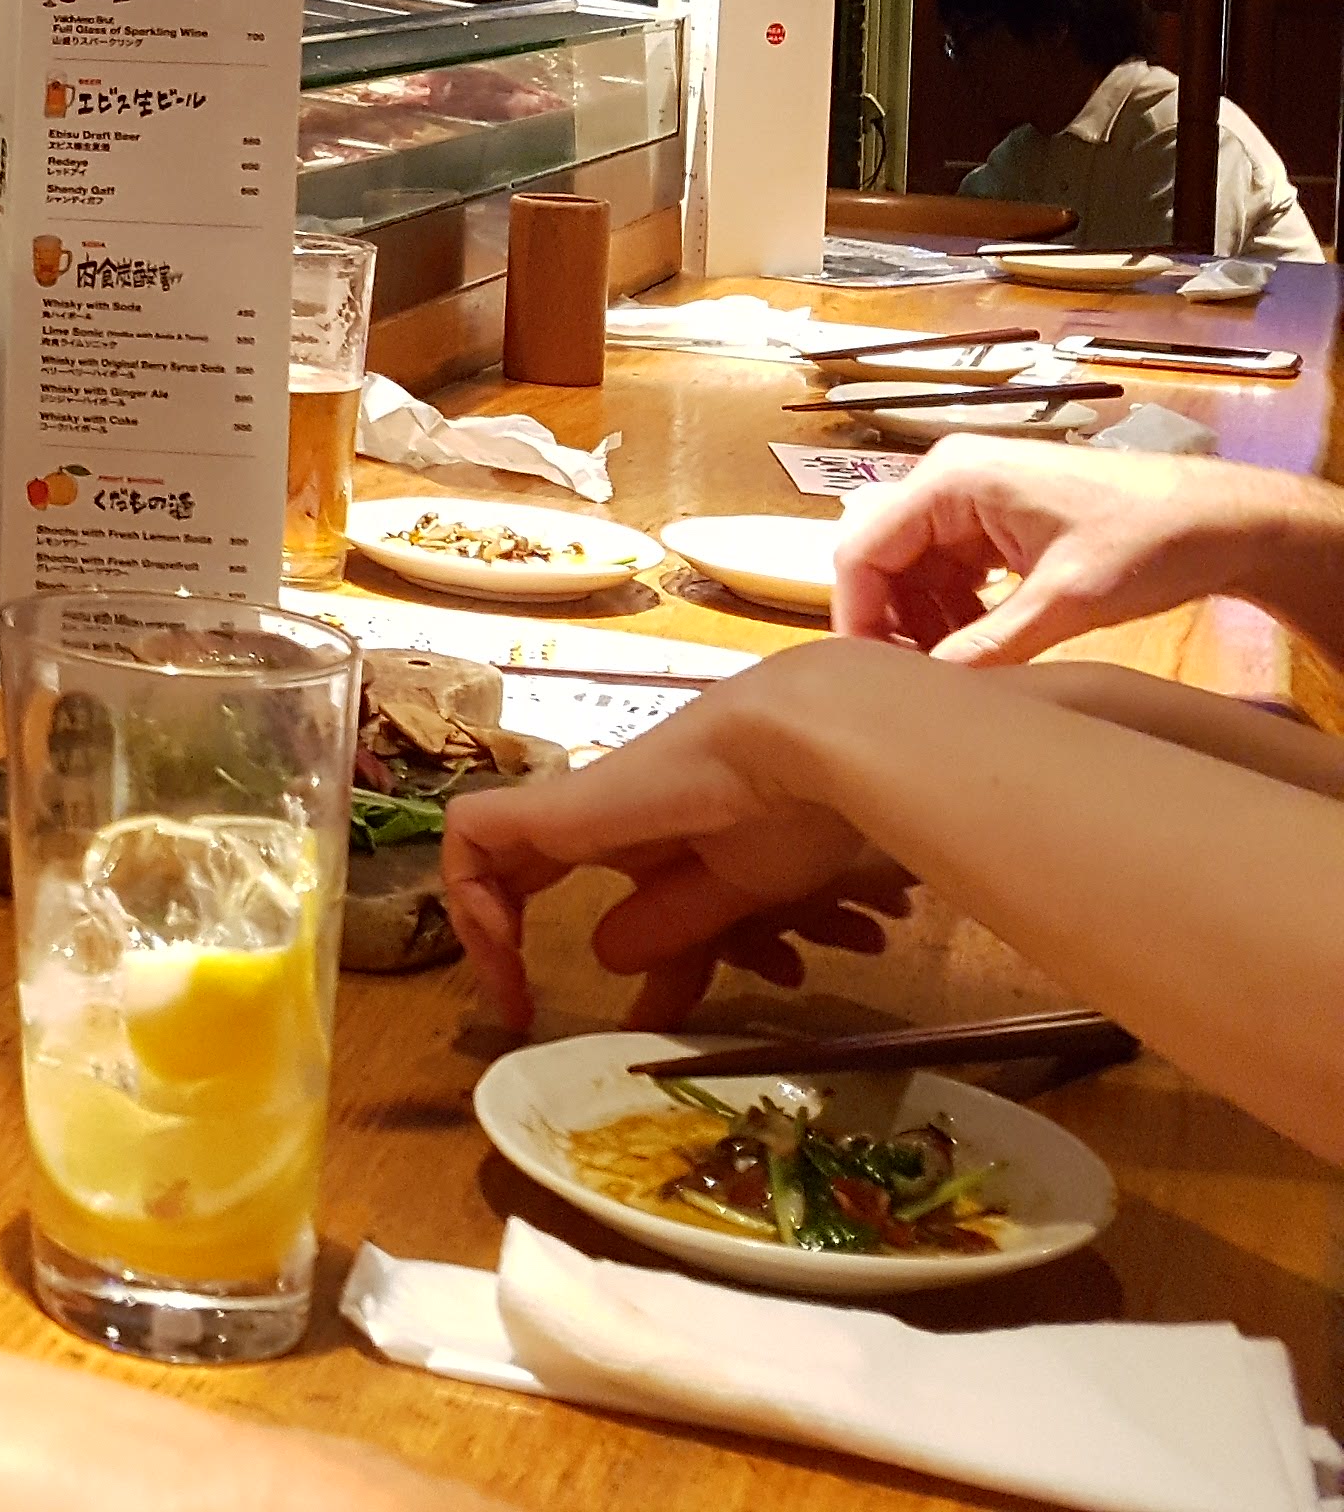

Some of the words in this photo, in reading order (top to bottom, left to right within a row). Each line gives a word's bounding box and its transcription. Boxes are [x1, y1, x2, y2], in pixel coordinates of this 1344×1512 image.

[52, 23, 73, 35] Full
[76, 25, 107, 36] Glass
[110, 26, 120, 35] of
[124, 26, 177, 38] Sparkling
[180, 27, 209, 37] Wine
[77, 87, 209, 118] エビス生ビール
[48, 129, 80, 139] Ebisu
[82, 131, 111, 141] Draft
[114, 131, 141, 141] Beer
[48, 157, 89, 169] Redeye
[46, 185, 89, 197] Shandy
[42, 298, 84, 312] Whisky
[86, 301, 110, 311] with
[113, 302, 142, 313] Soda
[42, 326, 69, 337] Lime
[150, 389, 169, 400] Ale
[39, 411, 80, 425] Whisky
